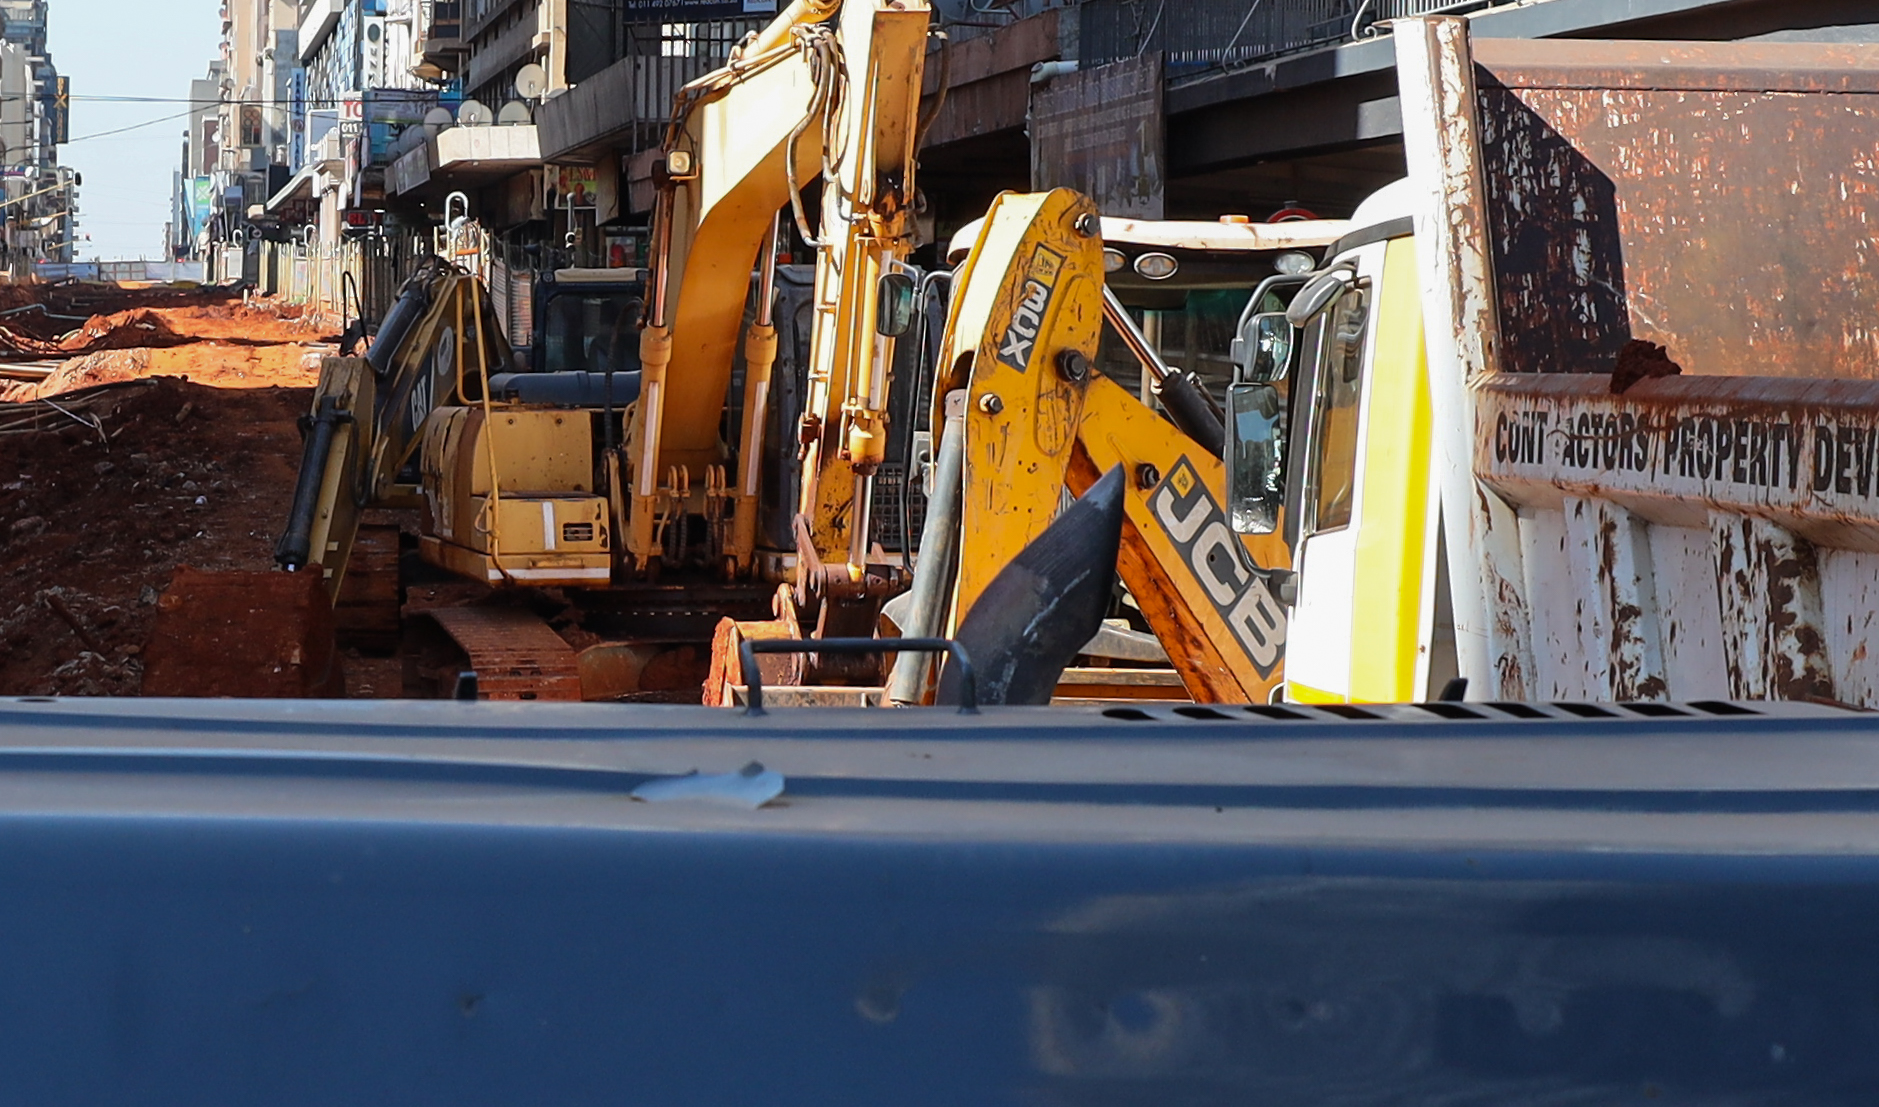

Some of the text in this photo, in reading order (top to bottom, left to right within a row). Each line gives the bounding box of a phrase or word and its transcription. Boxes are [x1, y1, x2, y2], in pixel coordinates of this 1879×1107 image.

[411, 374, 427, 432] CAT
[1494, 410, 1879, 498] CONTACTORS/PROPERTY DEV
[1156, 485, 1287, 668] JCB
